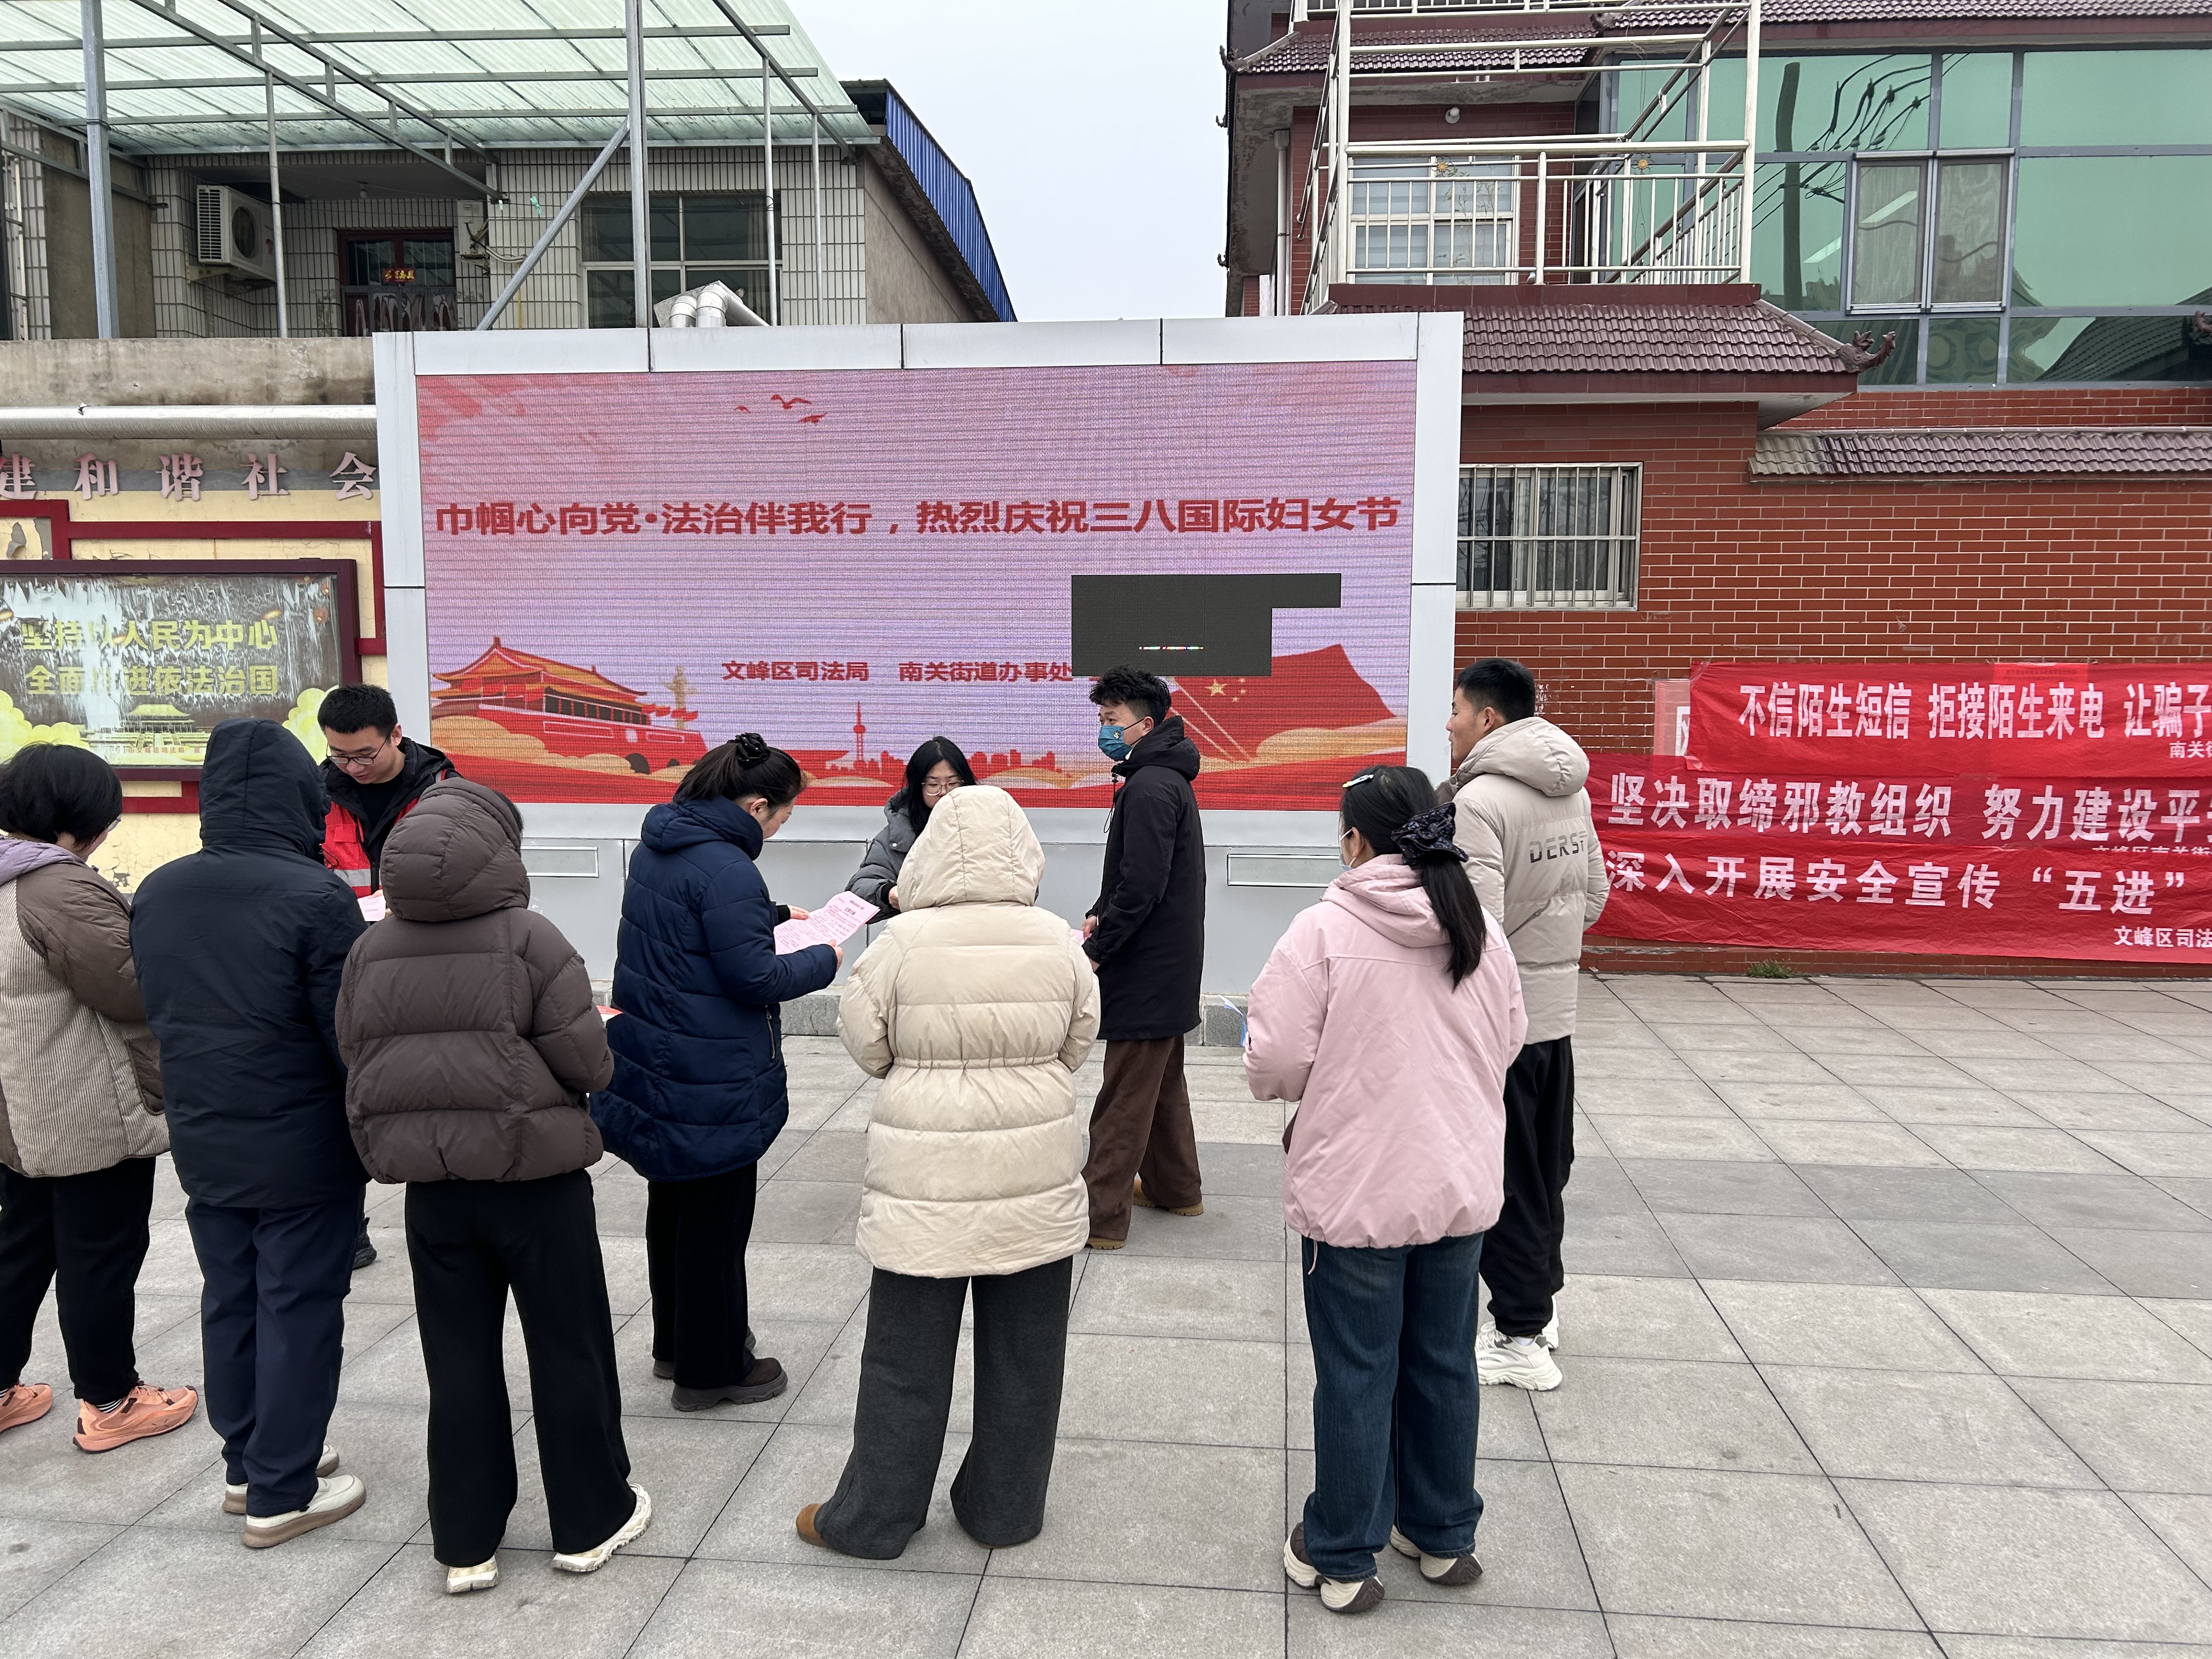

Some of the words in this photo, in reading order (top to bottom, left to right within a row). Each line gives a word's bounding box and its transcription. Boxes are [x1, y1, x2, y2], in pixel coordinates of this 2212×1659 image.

[721, 661, 869, 681] 文峰区司法局
[899, 661, 1073, 682] 南关街道办事处
[1738, 681, 1912, 740] 不信陌生短信
[1928, 681, 2104, 740] 拒接陌生来电
[2123, 681, 2211, 738] 让骗子
[1608, 772, 1951, 838] 坚决取缔邪教组织
[1981, 783, 2212, 843] 努力建设平
[2113, 925, 2212, 948] 文峰区司法
